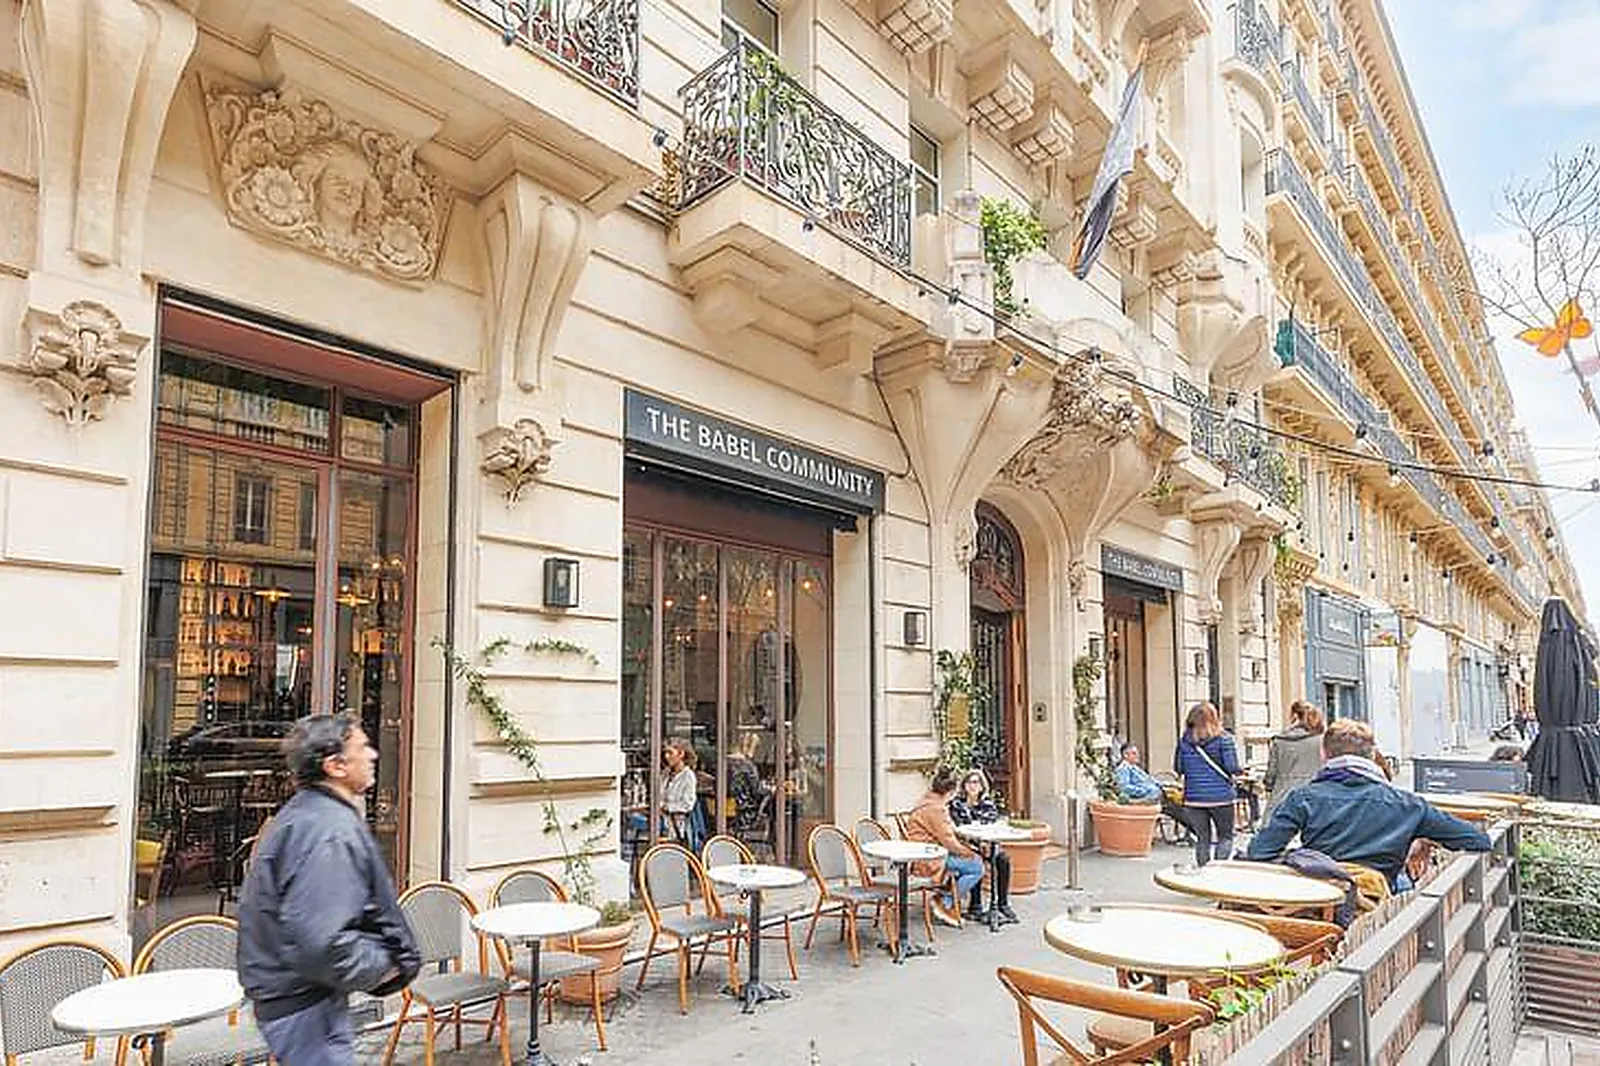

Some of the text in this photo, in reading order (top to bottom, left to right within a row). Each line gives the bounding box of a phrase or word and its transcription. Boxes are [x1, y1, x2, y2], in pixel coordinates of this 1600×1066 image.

[647, 407, 874, 496] THE BABEL COMMUNITY
